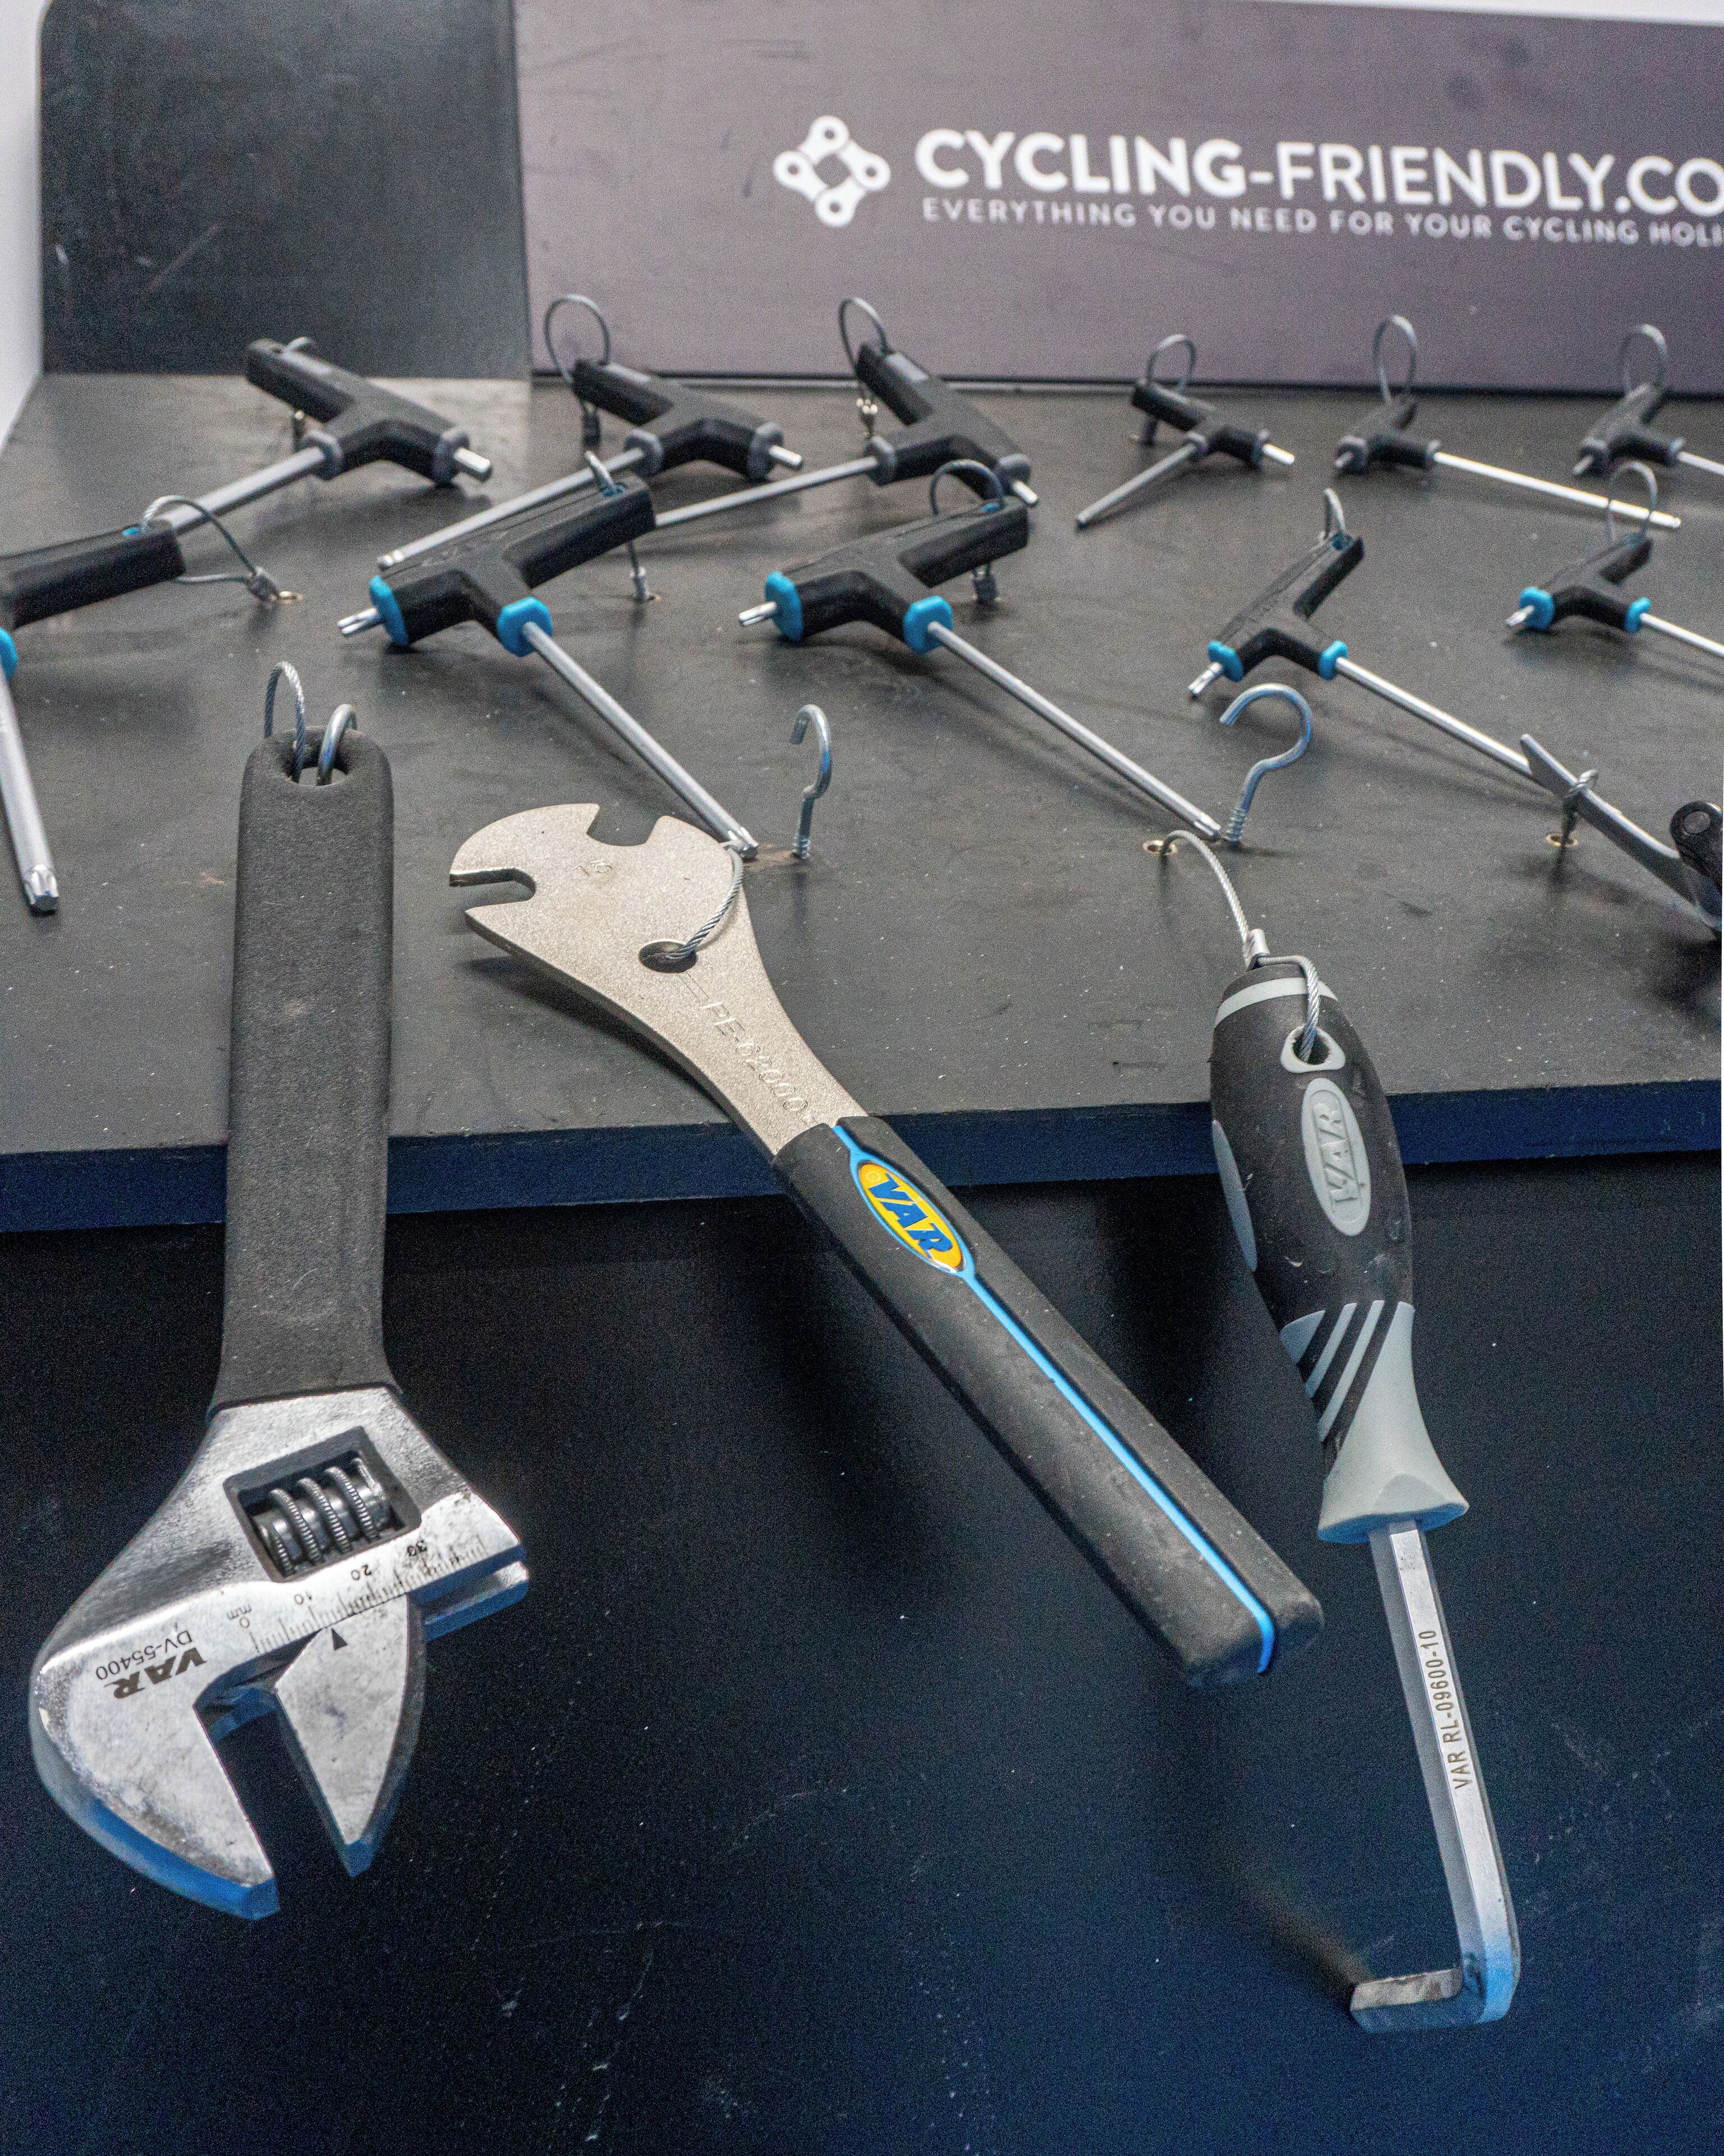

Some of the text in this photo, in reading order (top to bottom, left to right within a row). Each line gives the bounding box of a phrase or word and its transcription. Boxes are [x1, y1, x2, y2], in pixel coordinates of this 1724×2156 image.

[922, 197, 1137, 227] EVERYTHING
[1147, 203, 1215, 230] YOU
[1229, 207, 1317, 234] NEED
[1329, 209, 1394, 236] FOR
[1405, 212, 1492, 239] YOUR
[1503, 214, 1639, 245] CYCLING
[868, 1172, 953, 1259] VAR
[350, 1564, 372, 1581] 20
[226, 1604, 252, 1620] mm
[294, 1591, 313, 1605] 10
[95, 1630, 193, 1680] DV-55400
[104, 1647, 208, 1699] VAR
[1418, 1630, 1473, 1790] VAR RL-09600-10
